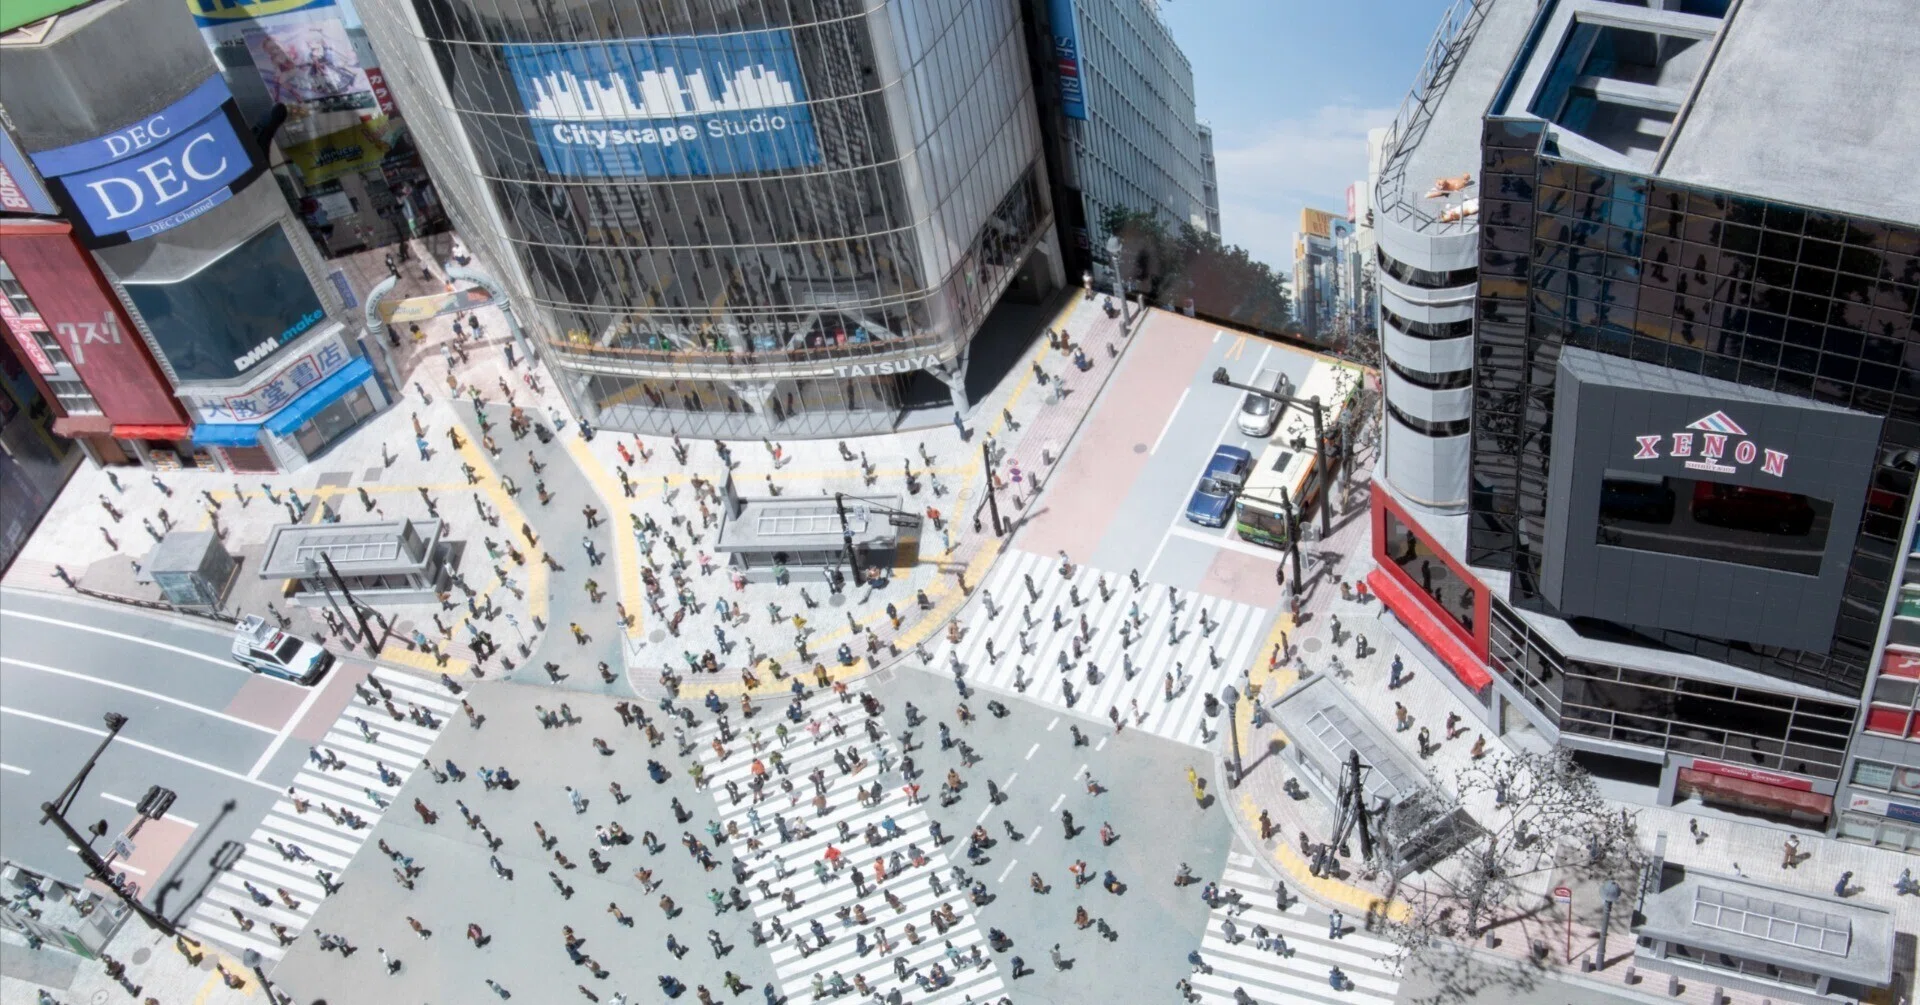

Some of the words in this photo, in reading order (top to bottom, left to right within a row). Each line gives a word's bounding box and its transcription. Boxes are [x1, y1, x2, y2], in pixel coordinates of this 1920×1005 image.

[1056, 37, 1081, 103] SEIBU
[103, 115, 171, 158] DEC
[553, 118, 698, 147] Cityscape
[706, 113, 787, 139] Studio
[86, 132, 228, 221] DEC
[149, 217, 174, 234] DEC
[175, 199, 214, 228] Channel
[234, 308, 324, 372] DMM.make
[199, 343, 351, 419] 大教堂書店
[834, 354, 940, 378] TATSUYA
[1634, 433, 1788, 477] XENON
